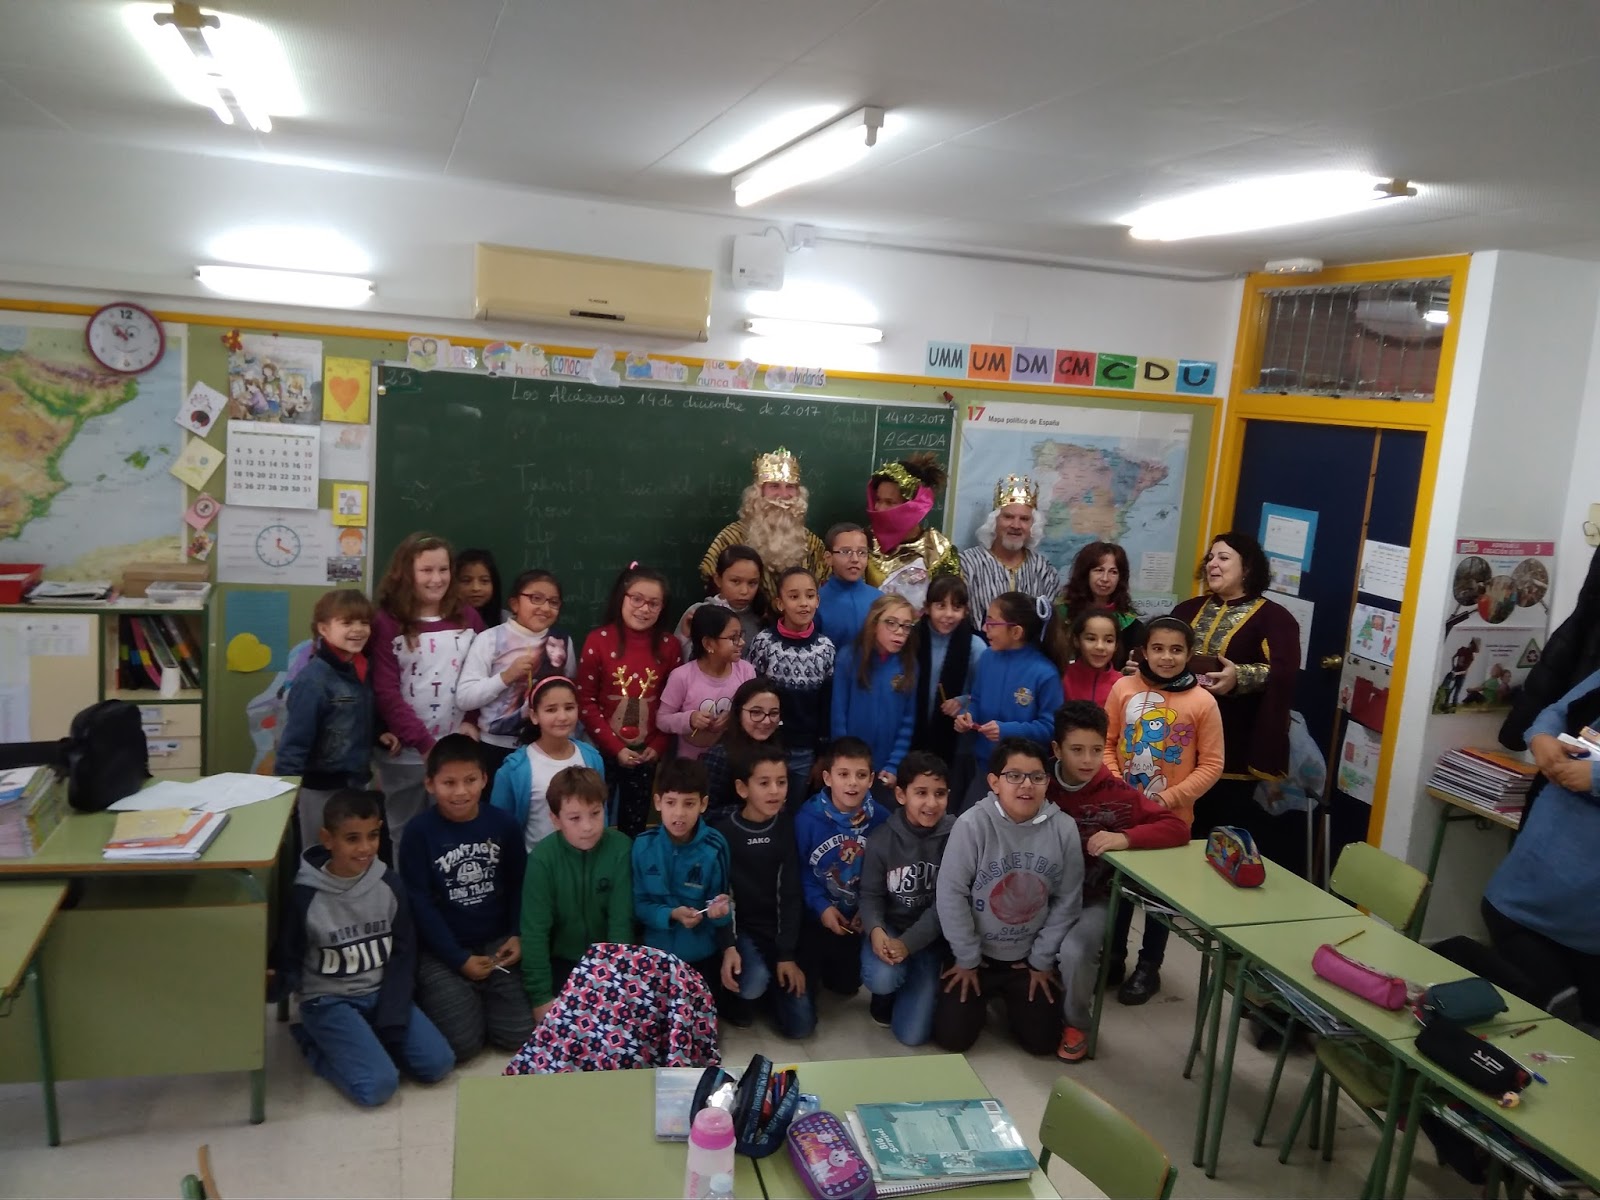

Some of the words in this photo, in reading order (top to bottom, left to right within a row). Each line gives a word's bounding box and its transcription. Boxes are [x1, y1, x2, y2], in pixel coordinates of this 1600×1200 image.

[120, 309, 133, 320] 12
[928, 347, 964, 369] UMM
[972, 351, 1007, 374] UM
[1016, 353, 1048, 374] DM
[1058, 355, 1090, 377] CM
[1102, 362, 1130, 381] C
[1144, 361, 1170, 382] D
[1183, 366, 1211, 387] U
[384, 368, 412, 386] 25
[698, 378, 729, 388] nunca
[511, 381, 539, 401] Los
[550, 385, 625, 405] Alcázares
[682, 395, 746, 412] diciembre
[759, 402, 775, 415] de
[885, 411, 946, 425] 14-12-2017
[967, 405, 986, 421] 17
[1006, 416, 1028, 424] político
[1038, 418, 1060, 427] España
[882, 431, 946, 447] AGENDA
[746, 836, 771, 846] JAKO
[434, 838, 501, 873] VINTAGE
[1000, 926, 1029, 936] State
